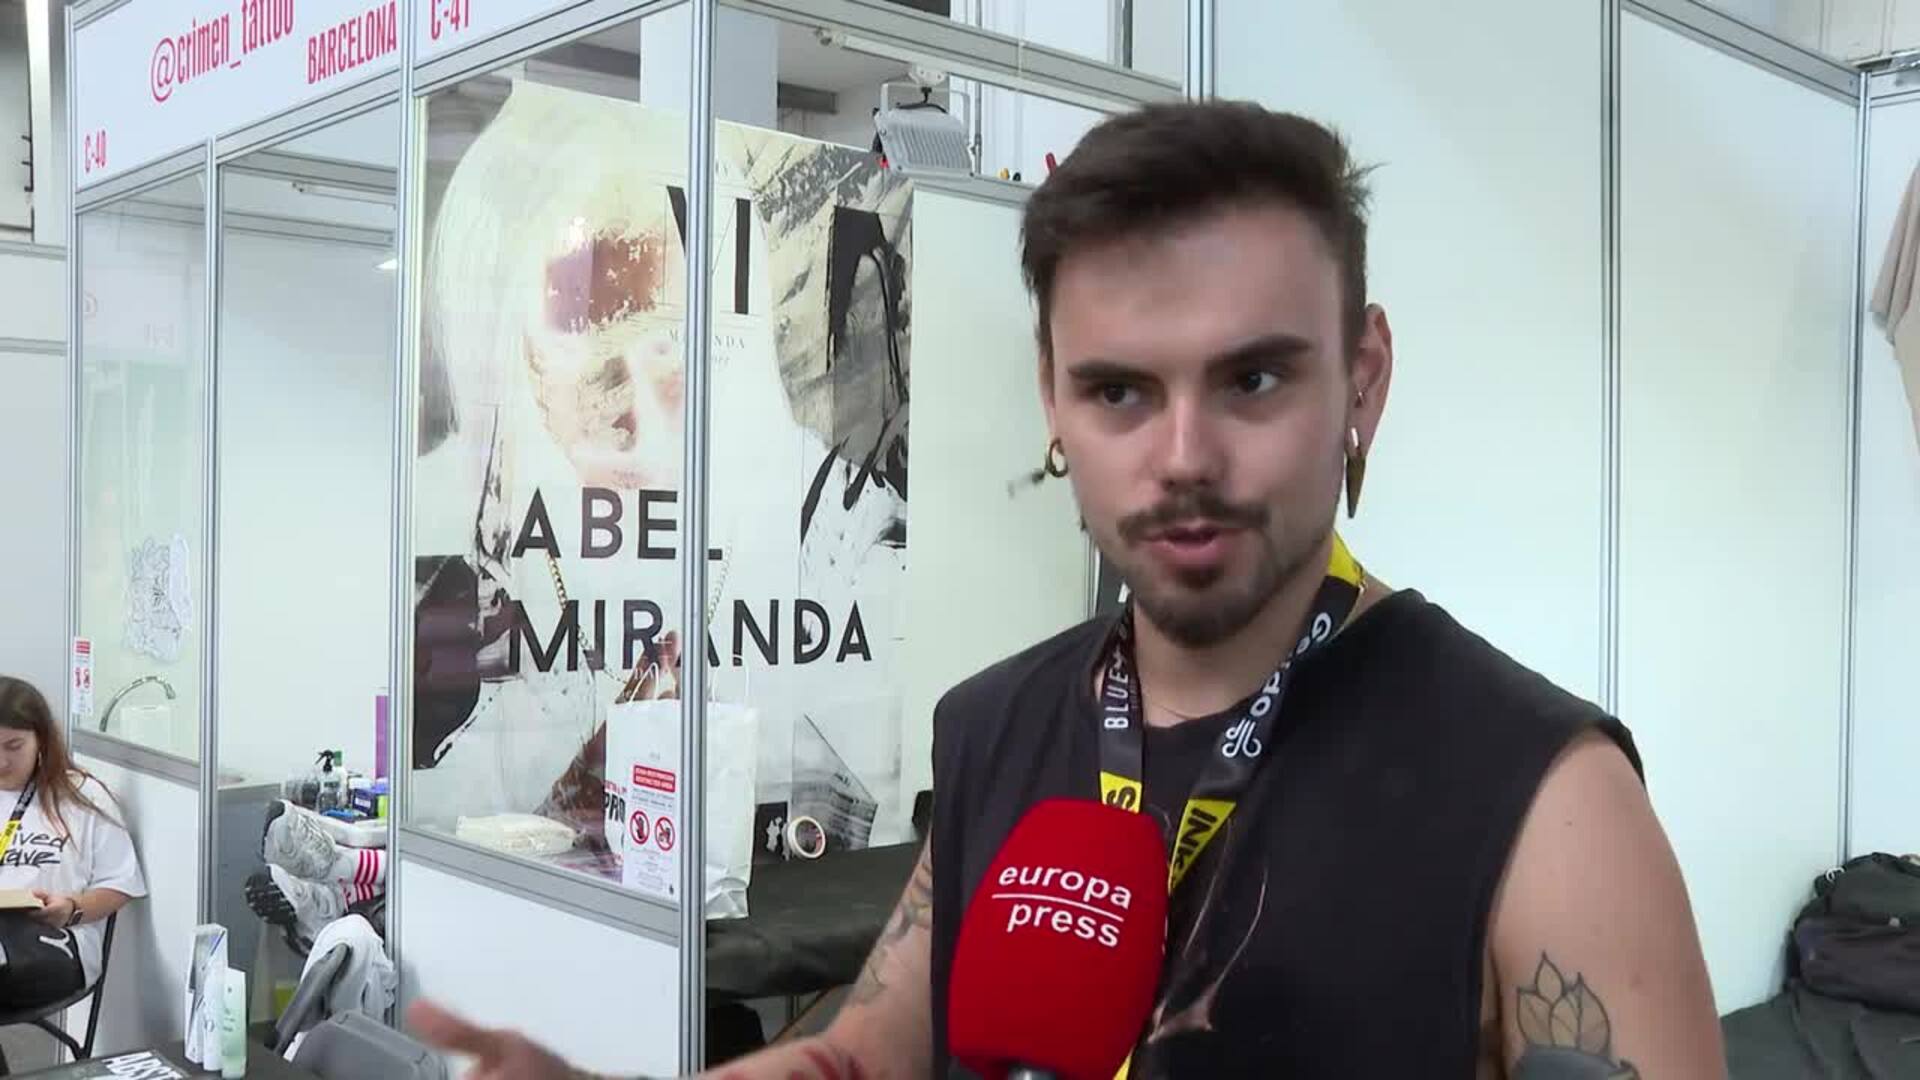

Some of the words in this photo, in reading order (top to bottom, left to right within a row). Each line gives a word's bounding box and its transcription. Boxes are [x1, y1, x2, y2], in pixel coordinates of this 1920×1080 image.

[307, 1, 397, 84] BARCELONA
[84, 129, 107, 173] C-40
[511, 486, 723, 561] ABE
[507, 599, 873, 673] MIRNDA
[998, 866, 1132, 909] europa
[1006, 903, 1121, 948] press
